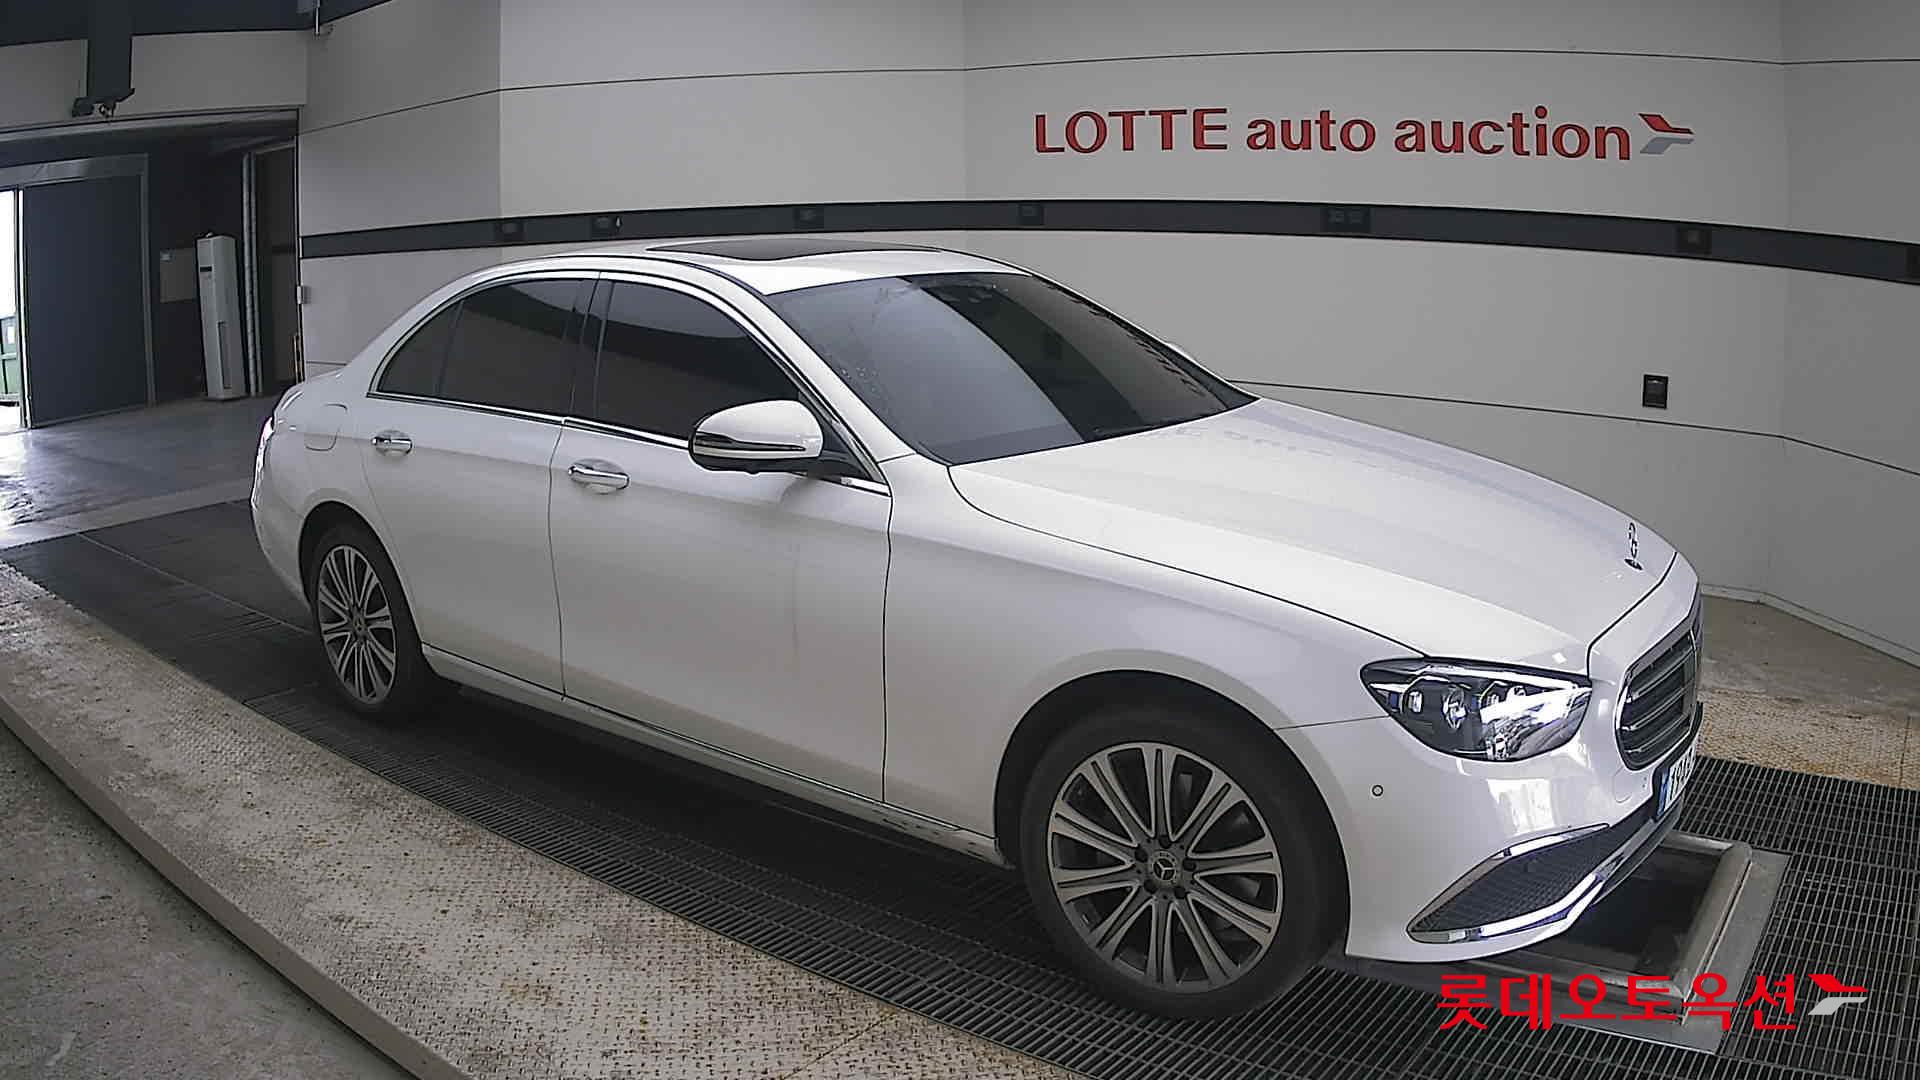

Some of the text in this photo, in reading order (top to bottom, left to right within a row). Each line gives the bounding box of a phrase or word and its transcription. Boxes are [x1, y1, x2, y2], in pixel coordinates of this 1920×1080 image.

[1034, 106, 1632, 161] LOTTE auto auction
